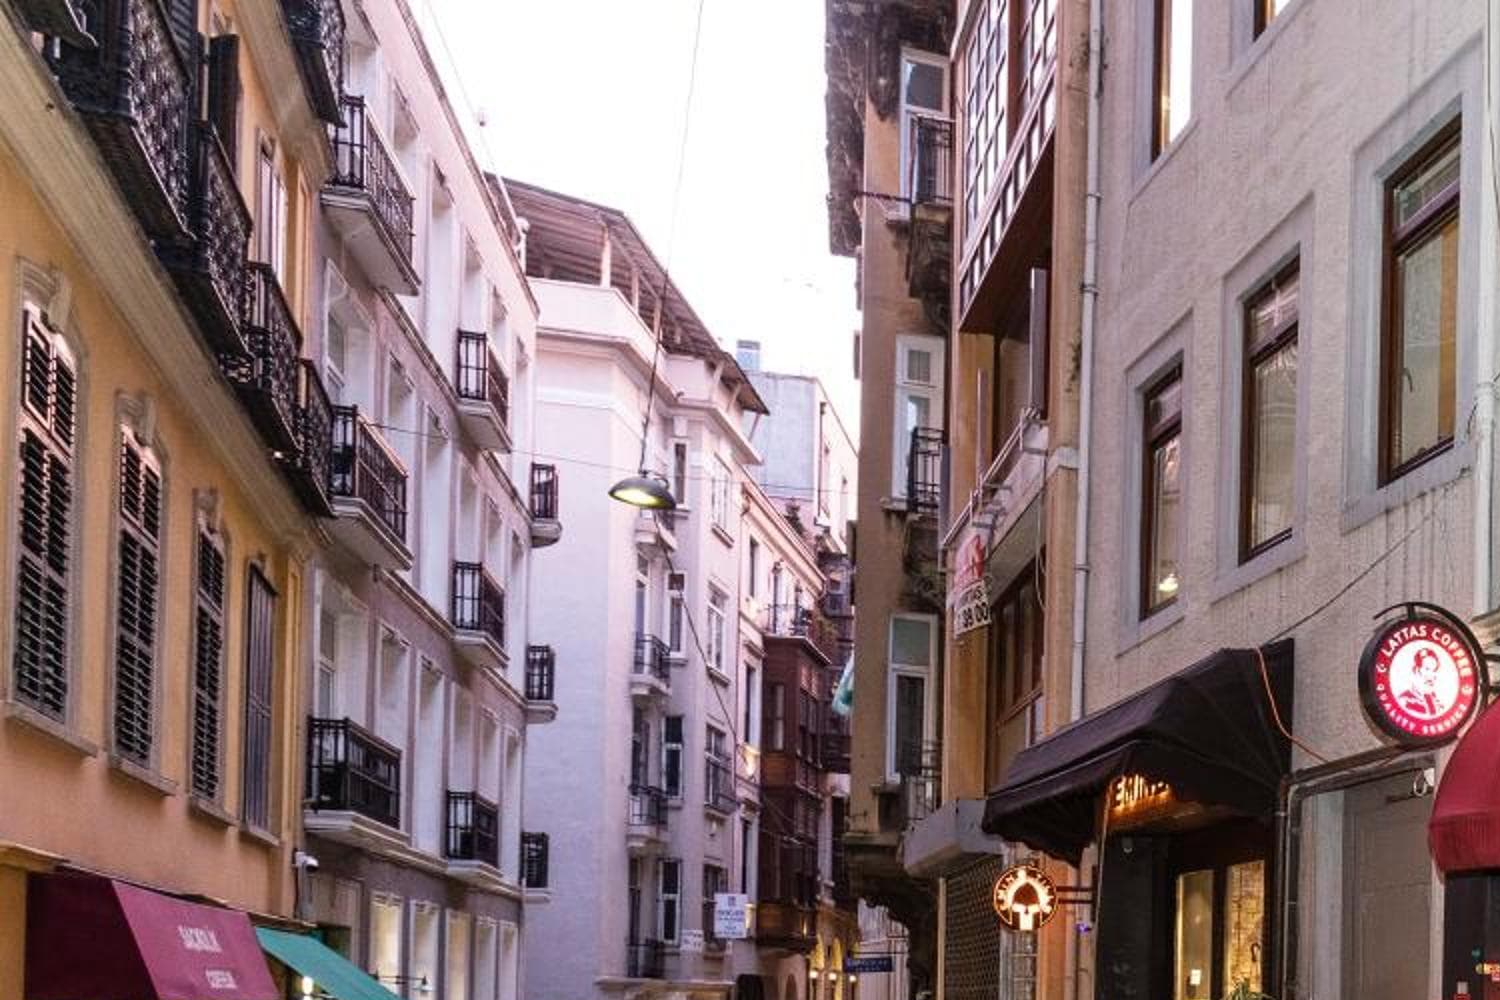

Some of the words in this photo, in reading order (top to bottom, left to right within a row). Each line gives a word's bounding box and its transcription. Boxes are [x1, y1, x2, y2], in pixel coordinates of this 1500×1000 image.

[1382, 625, 1427, 657] LATTAS
[1431, 628, 1473, 676] COFFEE
[1376, 684, 1416, 731] QUALITY
